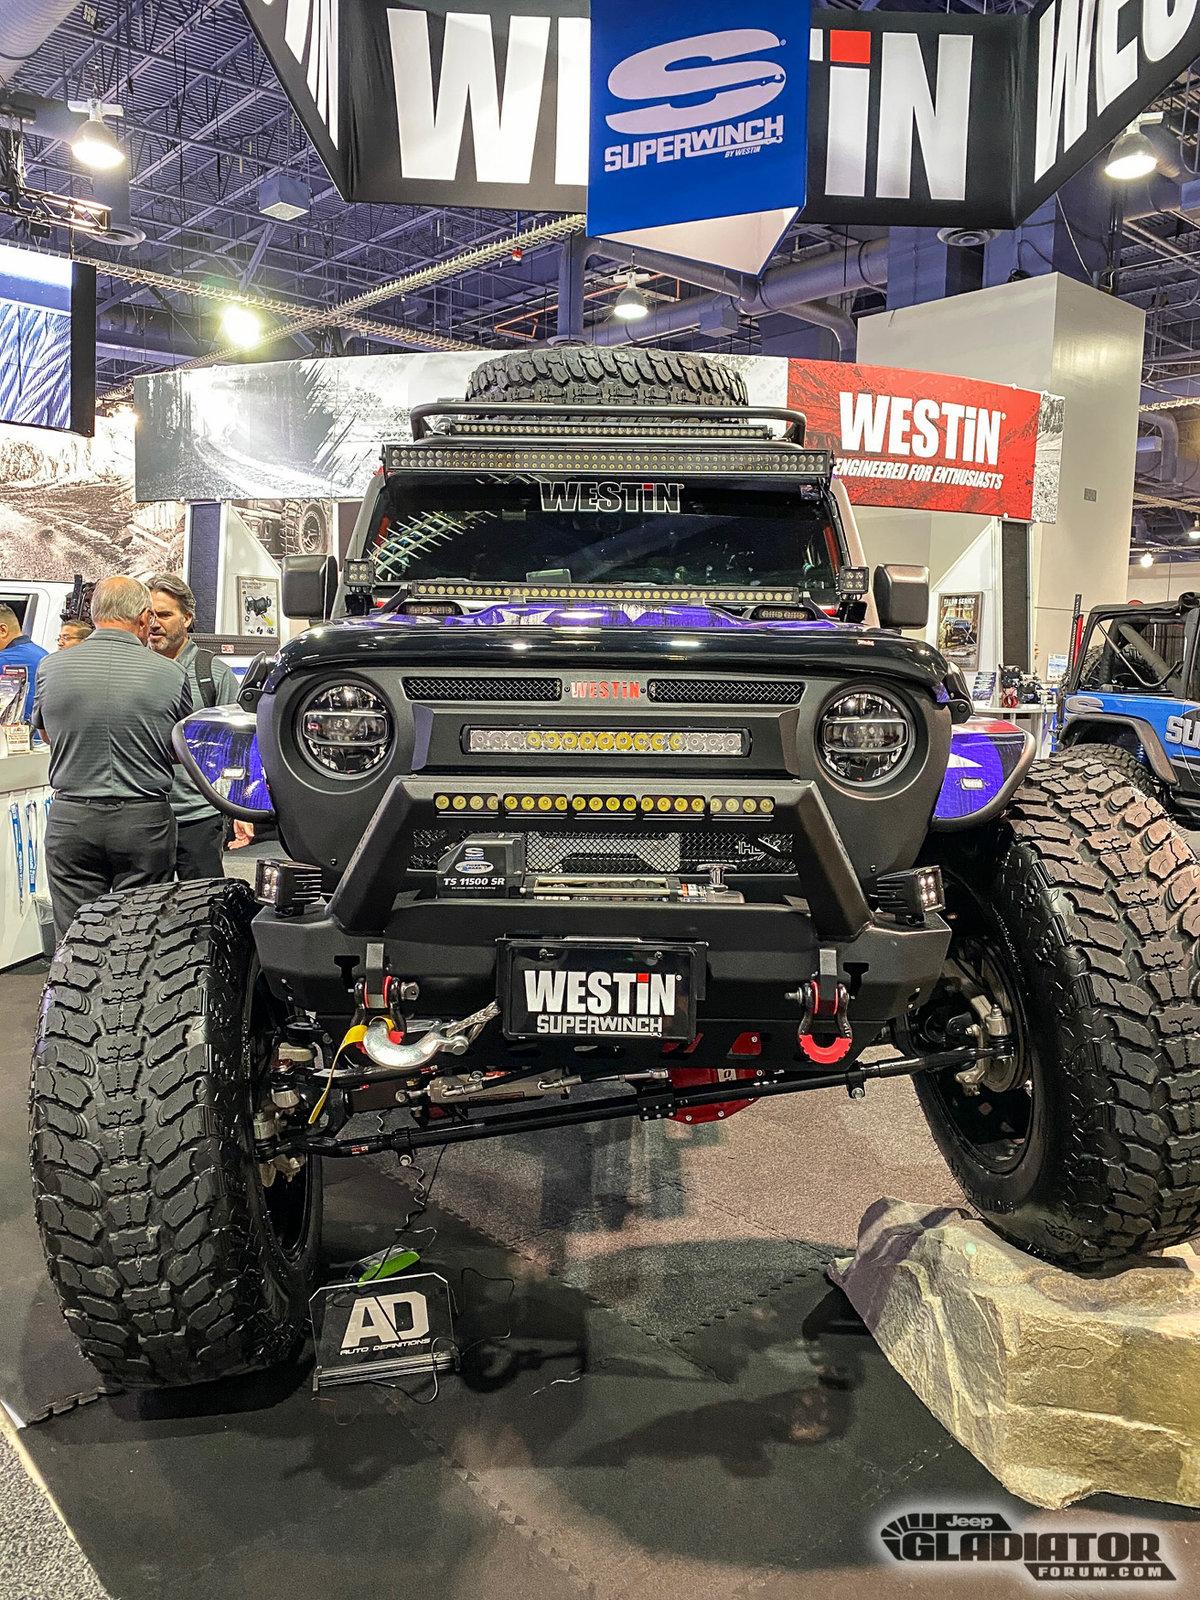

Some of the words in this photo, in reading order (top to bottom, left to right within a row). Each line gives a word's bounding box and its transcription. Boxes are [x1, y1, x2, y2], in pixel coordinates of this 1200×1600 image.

[604, 115, 784, 172] SUPERWINCH
[833, 457, 909, 480] ENGINEERED
[907, 464, 934, 482] FOR
[931, 466, 1004, 490] ENTHUSIASTS
[443, 877, 457, 886] TS
[460, 877, 488, 886] 11500
[490, 877, 506, 886] SR
[536, 1014, 663, 1037] SUPERWINCH
[341, 1291, 430, 1349] AD
[340, 1346, 369, 1356] AUTO
[372, 1338, 431, 1351] DEFINITIONS
